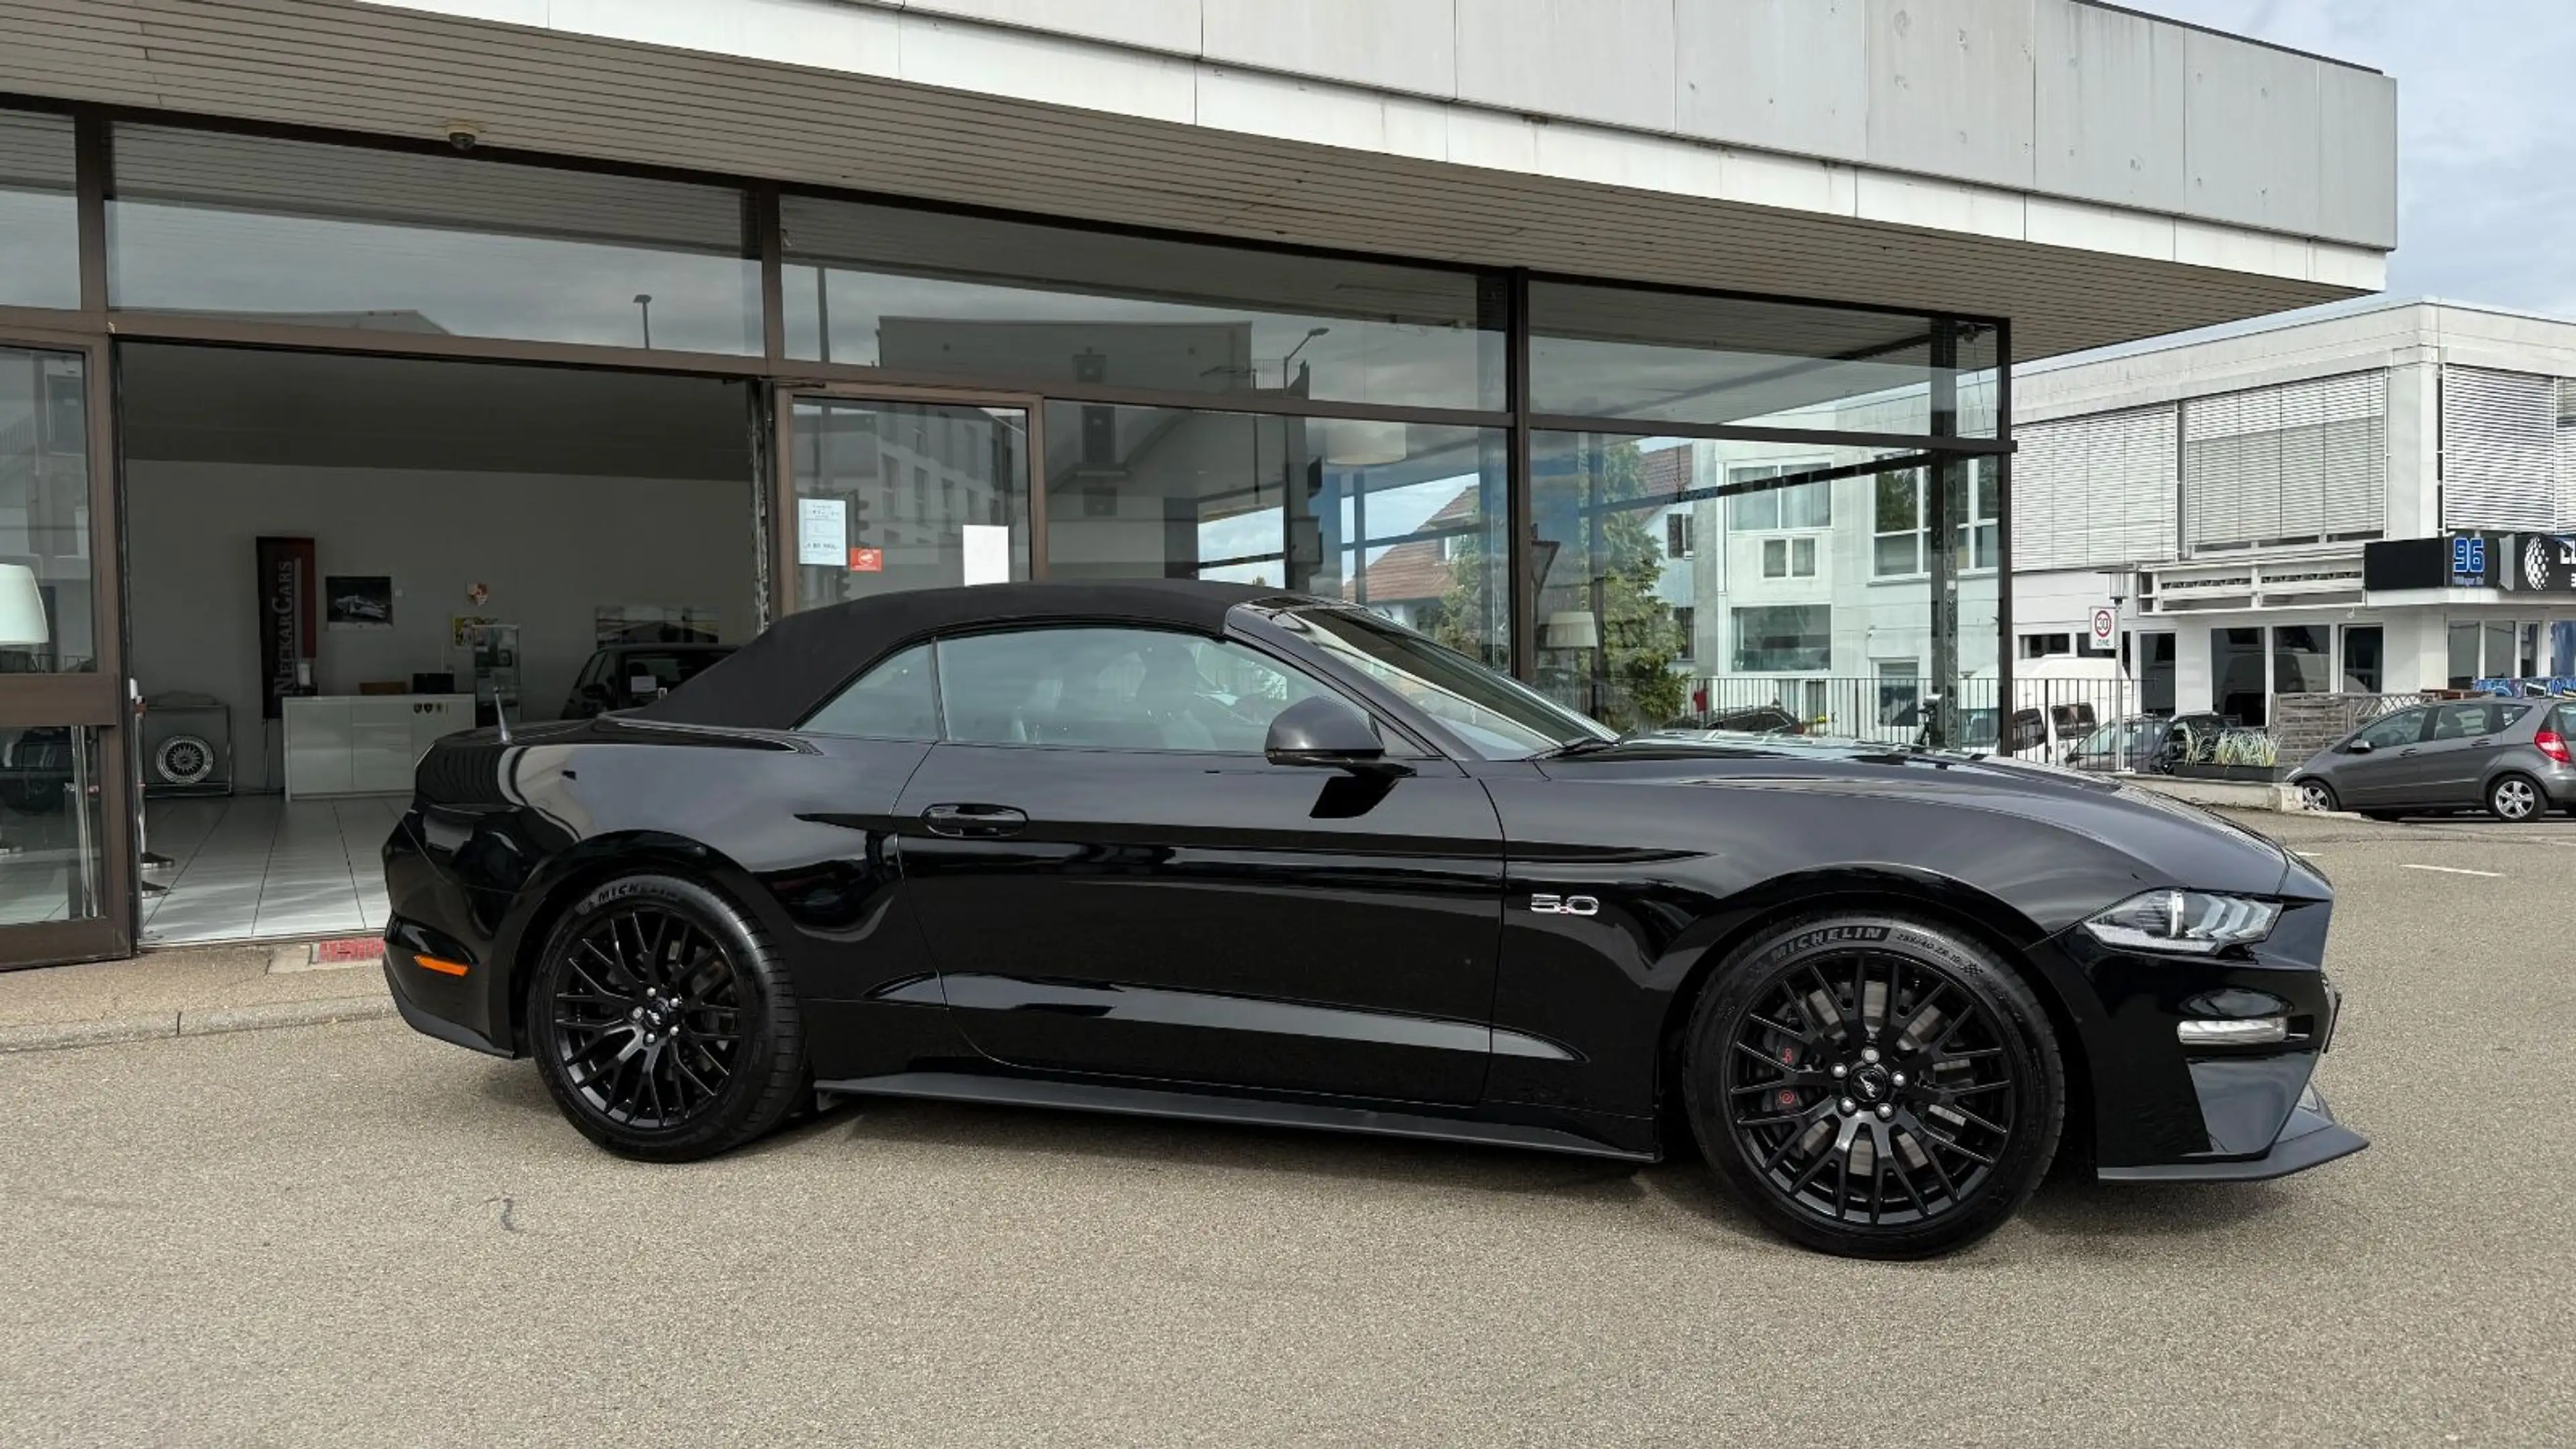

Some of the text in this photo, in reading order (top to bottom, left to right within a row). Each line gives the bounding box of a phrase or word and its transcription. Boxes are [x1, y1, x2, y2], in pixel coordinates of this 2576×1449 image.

[2453, 537, 2485, 572] 96
[2098, 618, 2108, 630] 30
[1530, 894, 1599, 915] 5.0
[1770, 927, 1882, 962] MICHELIN
